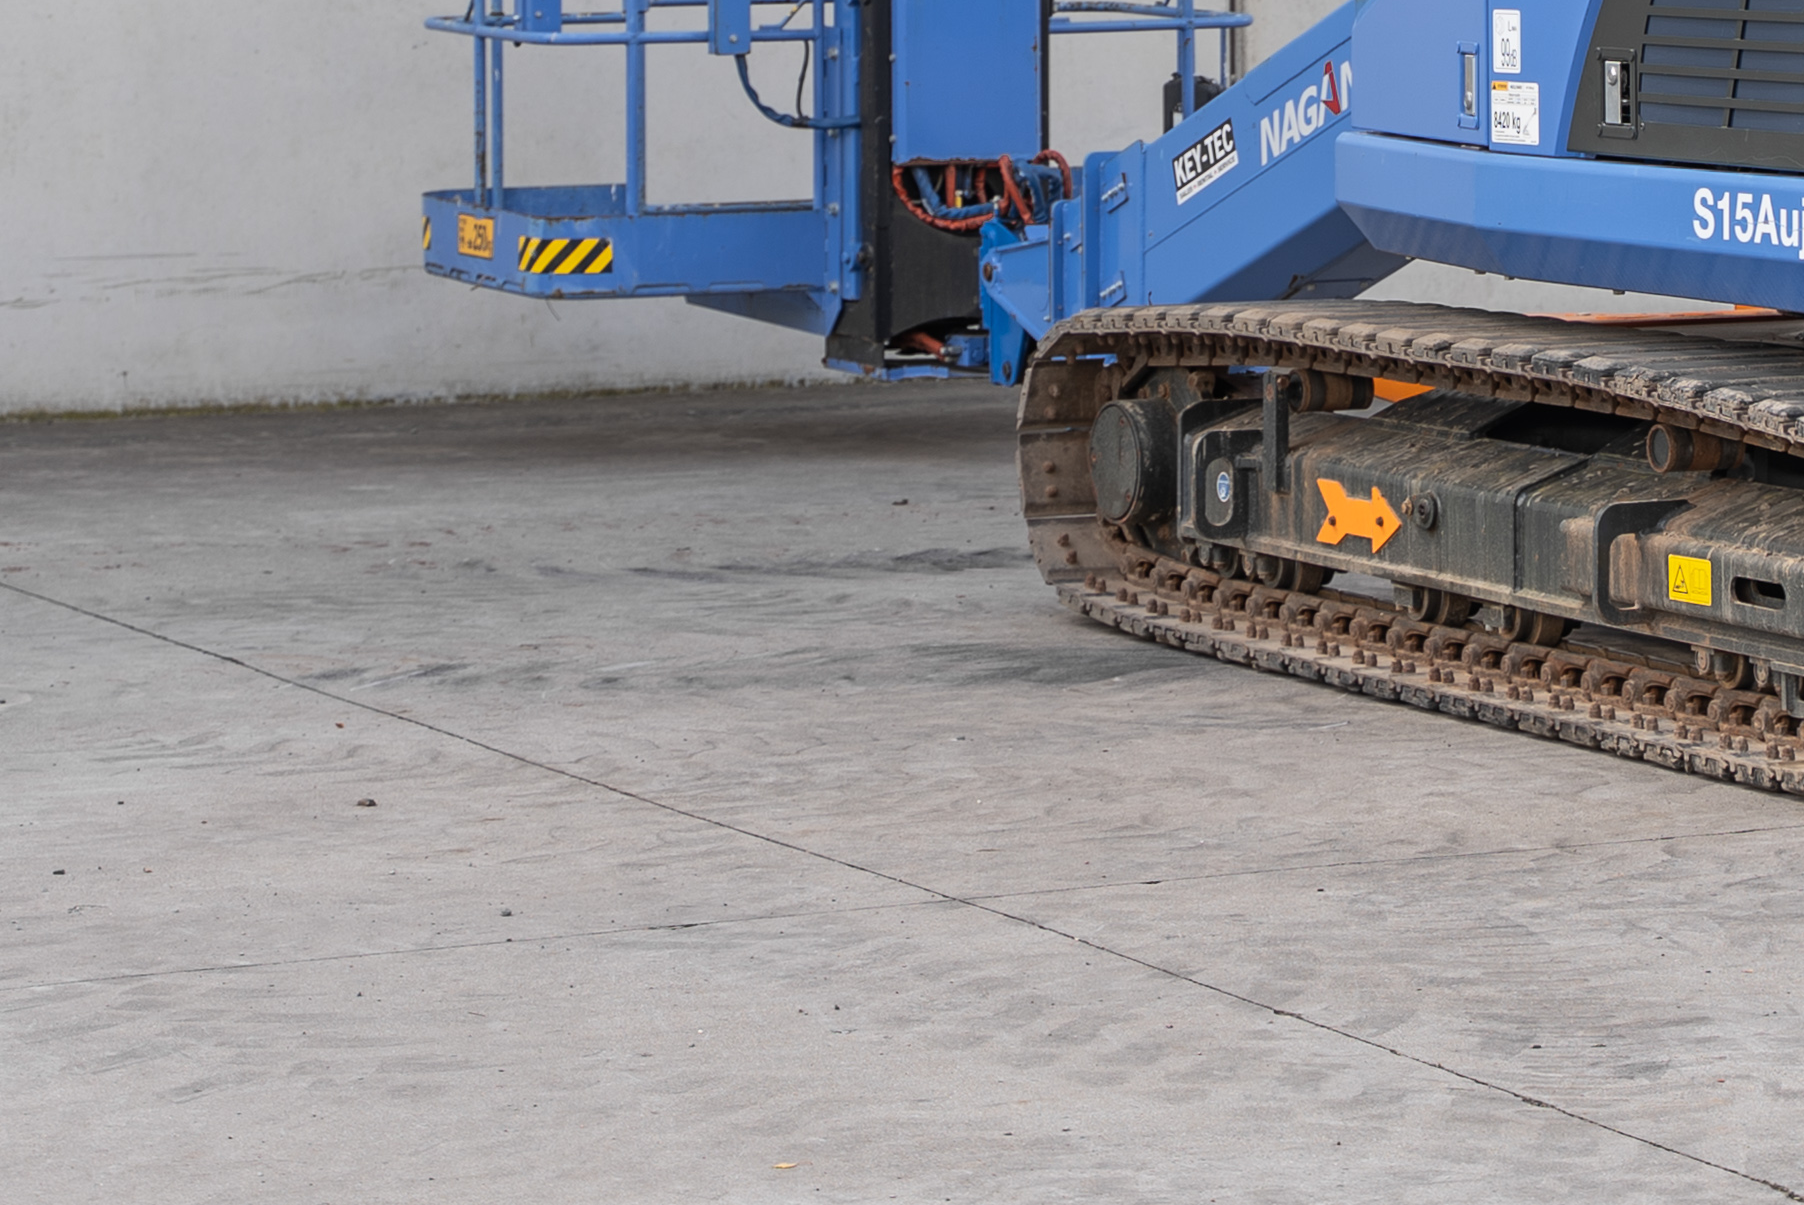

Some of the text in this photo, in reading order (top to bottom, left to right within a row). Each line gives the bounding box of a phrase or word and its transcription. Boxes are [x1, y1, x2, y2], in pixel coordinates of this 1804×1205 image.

[1259, 60, 1353, 167] NAGAN
[1493, 111, 1521, 134] 8420 kg
[1174, 123, 1234, 188] KEY-TEC
